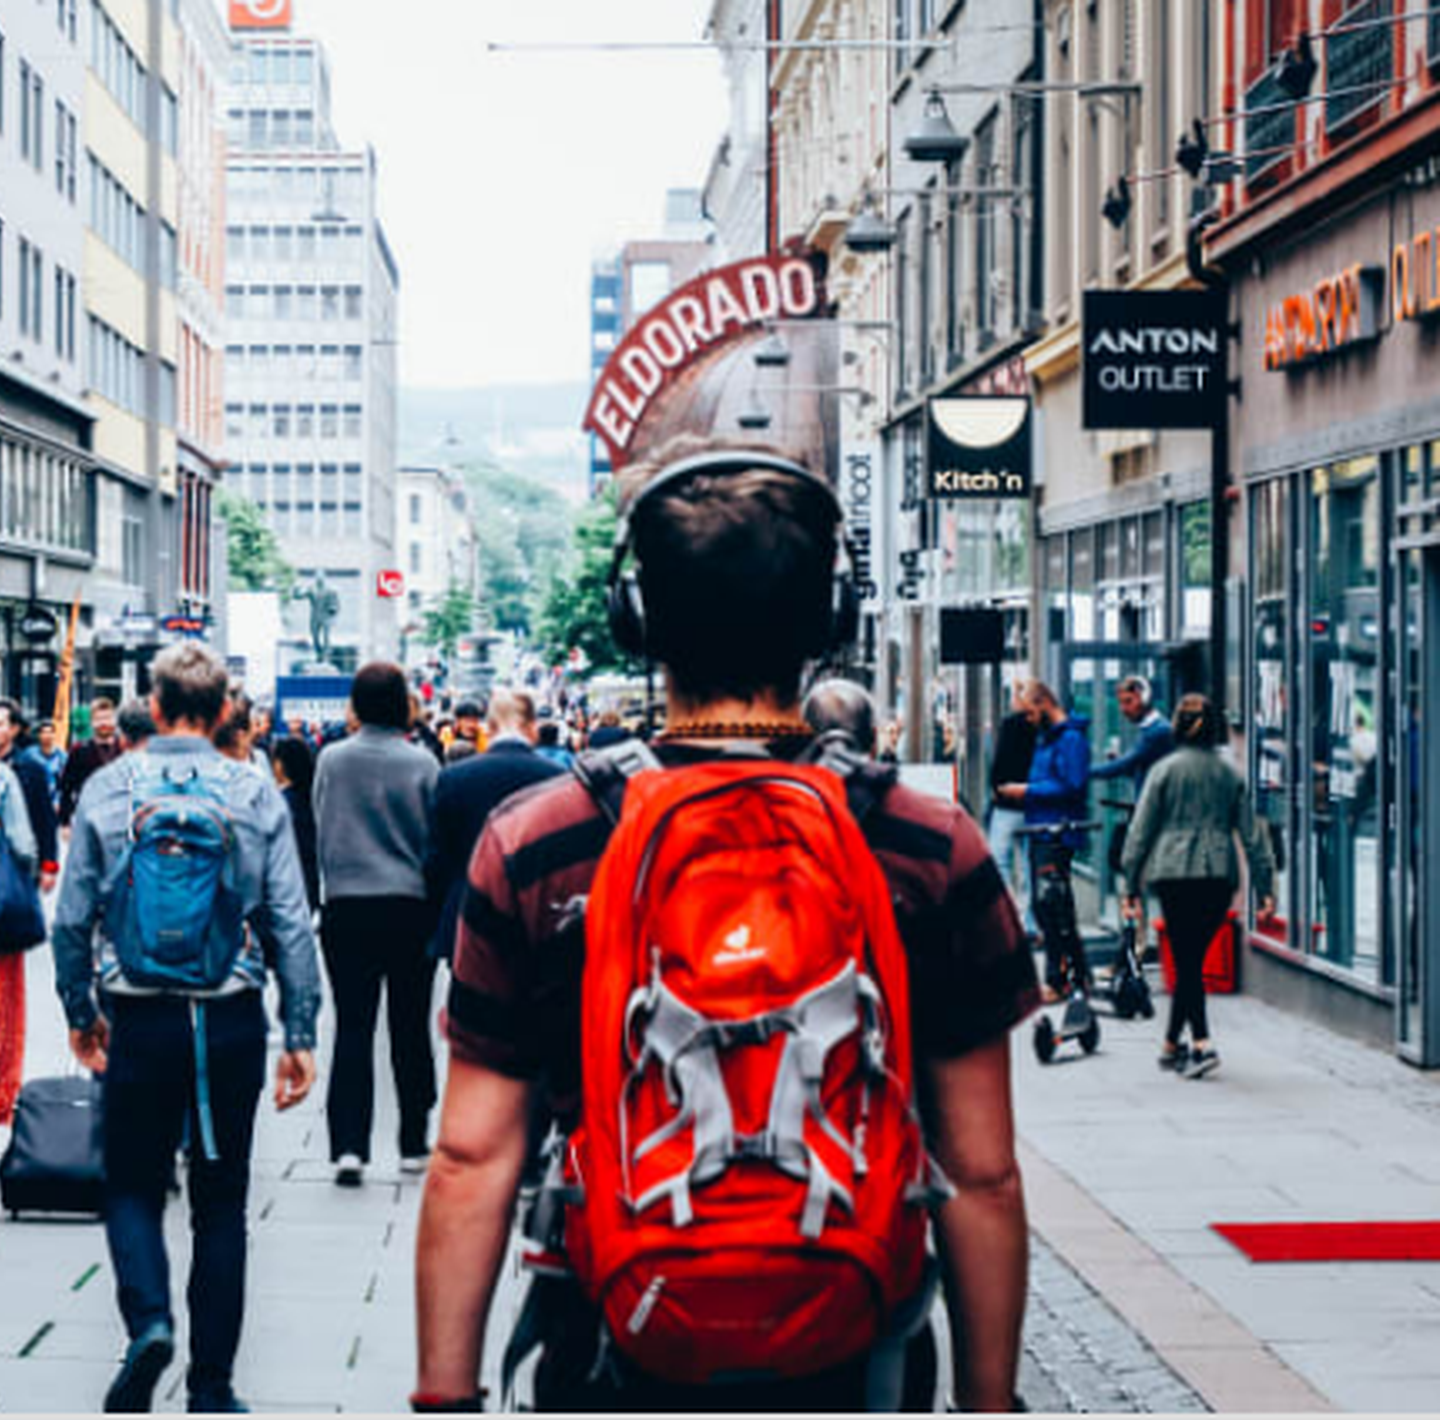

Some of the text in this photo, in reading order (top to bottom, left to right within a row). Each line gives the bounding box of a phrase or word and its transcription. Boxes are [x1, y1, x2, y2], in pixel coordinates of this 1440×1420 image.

[1090, 326, 1218, 354] ANTON
[593, 261, 817, 449] ELDORADO
[1098, 365, 1210, 391] OUTLET
